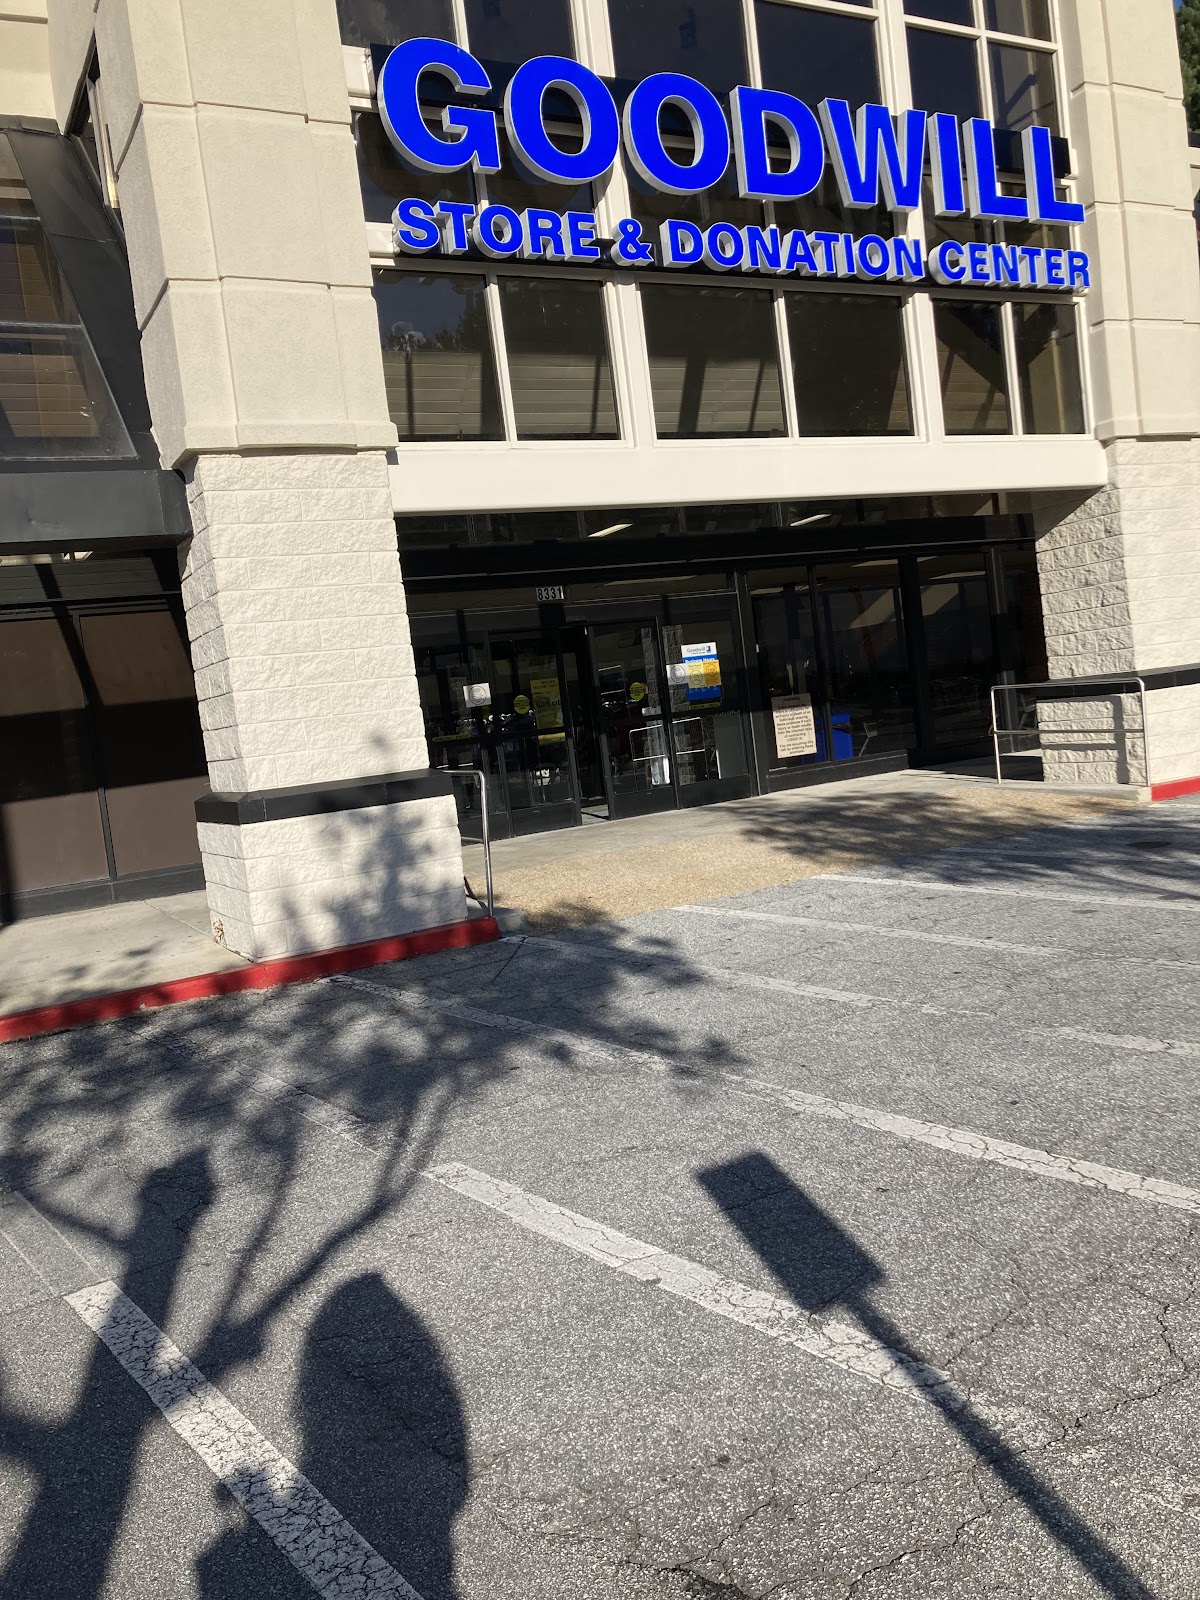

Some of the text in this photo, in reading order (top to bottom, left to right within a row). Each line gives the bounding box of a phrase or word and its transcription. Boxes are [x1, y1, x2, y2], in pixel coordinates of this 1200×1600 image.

[378, 37, 1085, 225] GOODWILL
[395, 198, 1090, 288] STORE & DONATION CENTER
[537, 586, 563, 600] 8331
